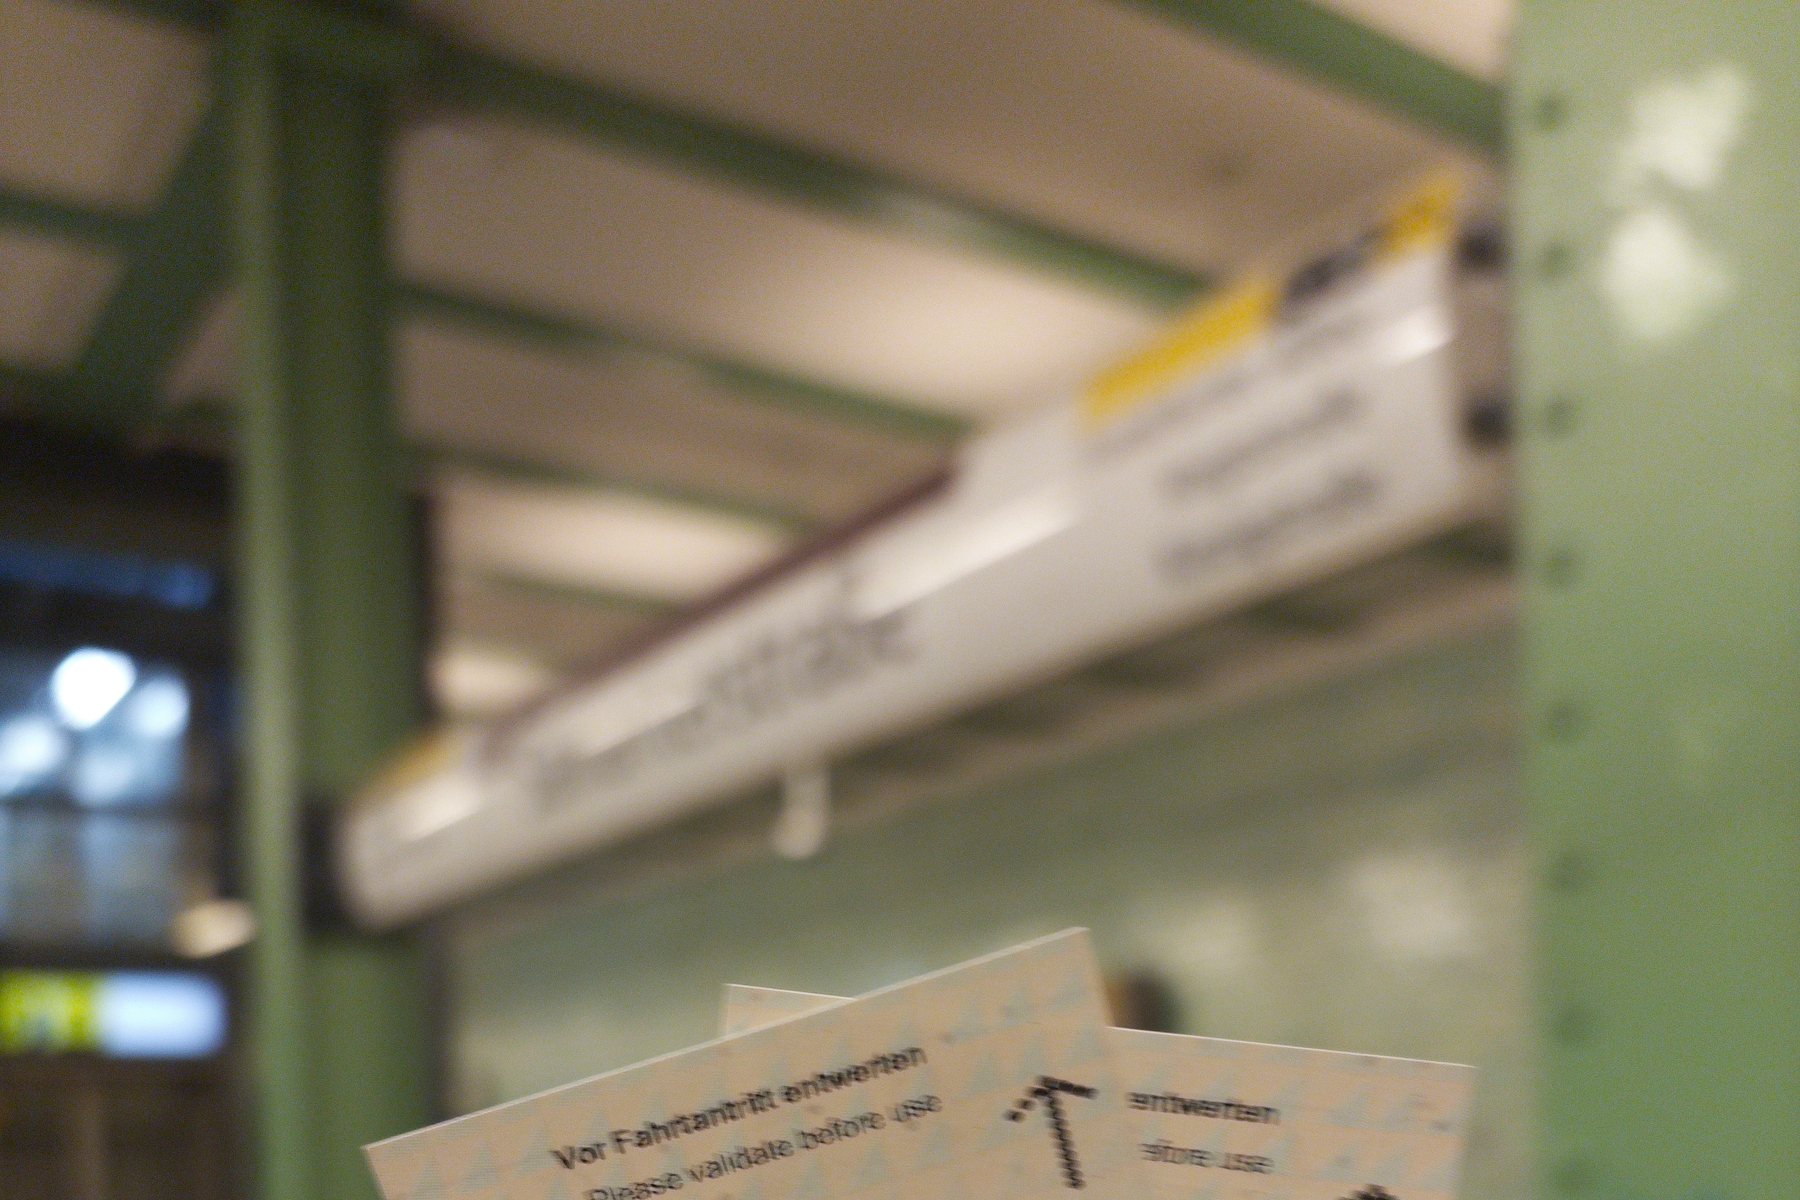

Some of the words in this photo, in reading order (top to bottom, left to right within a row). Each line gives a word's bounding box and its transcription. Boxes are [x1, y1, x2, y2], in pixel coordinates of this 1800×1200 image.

[551, 1140, 608, 1170] Vor
[611, 1086, 778, 1155] Fahrtantritt
[782, 1046, 928, 1102] entwerten
[686, 1138, 795, 1184] validate
[798, 1110, 887, 1152] before
[891, 1094, 943, 1125] use
[1137, 1138, 1213, 1168] efore
